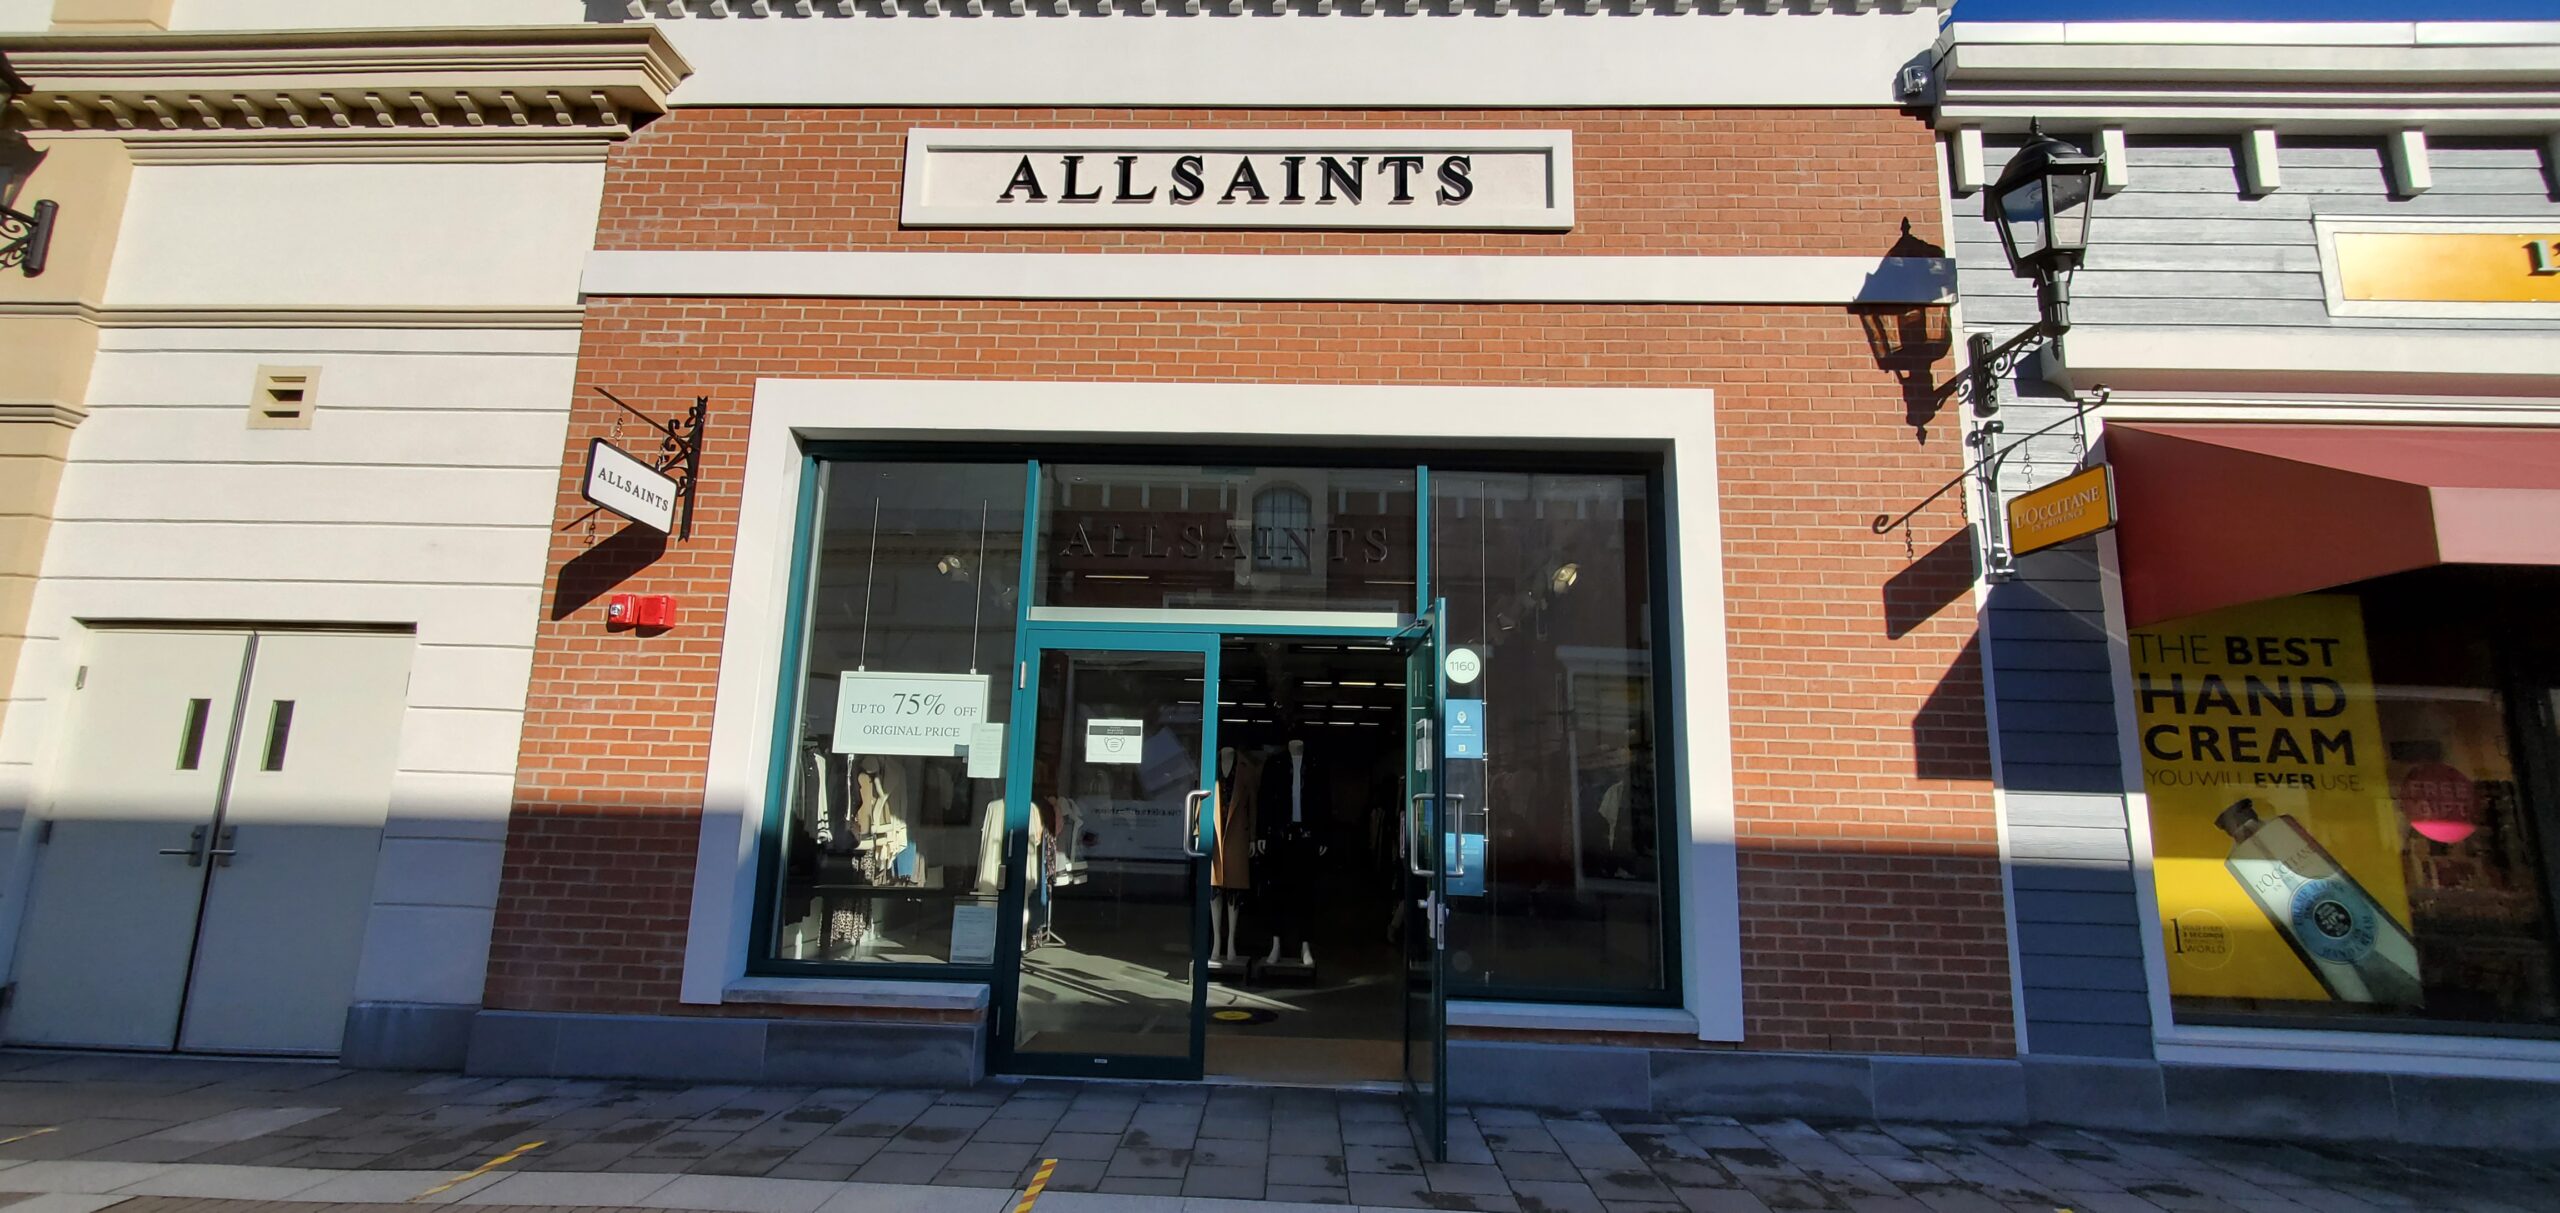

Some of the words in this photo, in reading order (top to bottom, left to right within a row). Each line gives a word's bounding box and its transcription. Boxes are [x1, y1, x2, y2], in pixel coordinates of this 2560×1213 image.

[997, 153, 1475, 206] ALLSAINTS
[598, 467, 669, 512] ALLSAINTS
[2015, 486, 2100, 529] L'OCCITANE
[1059, 521, 1388, 563] ALLSAINTS
[1450, 661, 1475, 672] 1160
[2130, 634, 2211, 664] THE
[2225, 635, 2340, 667] BEST
[851, 703, 868, 714] UP
[869, 704, 886, 714] TO
[892, 693, 946, 716] 75%
[953, 706, 977, 717] OFF
[2138, 672, 2347, 718] HAND
[862, 724, 922, 737] ORIGINAL
[925, 727, 961, 738] PRICE
[2144, 724, 2357, 766] CREAM
[2146, 768, 2193, 786] YOU
[2253, 771, 2317, 790] EVER
